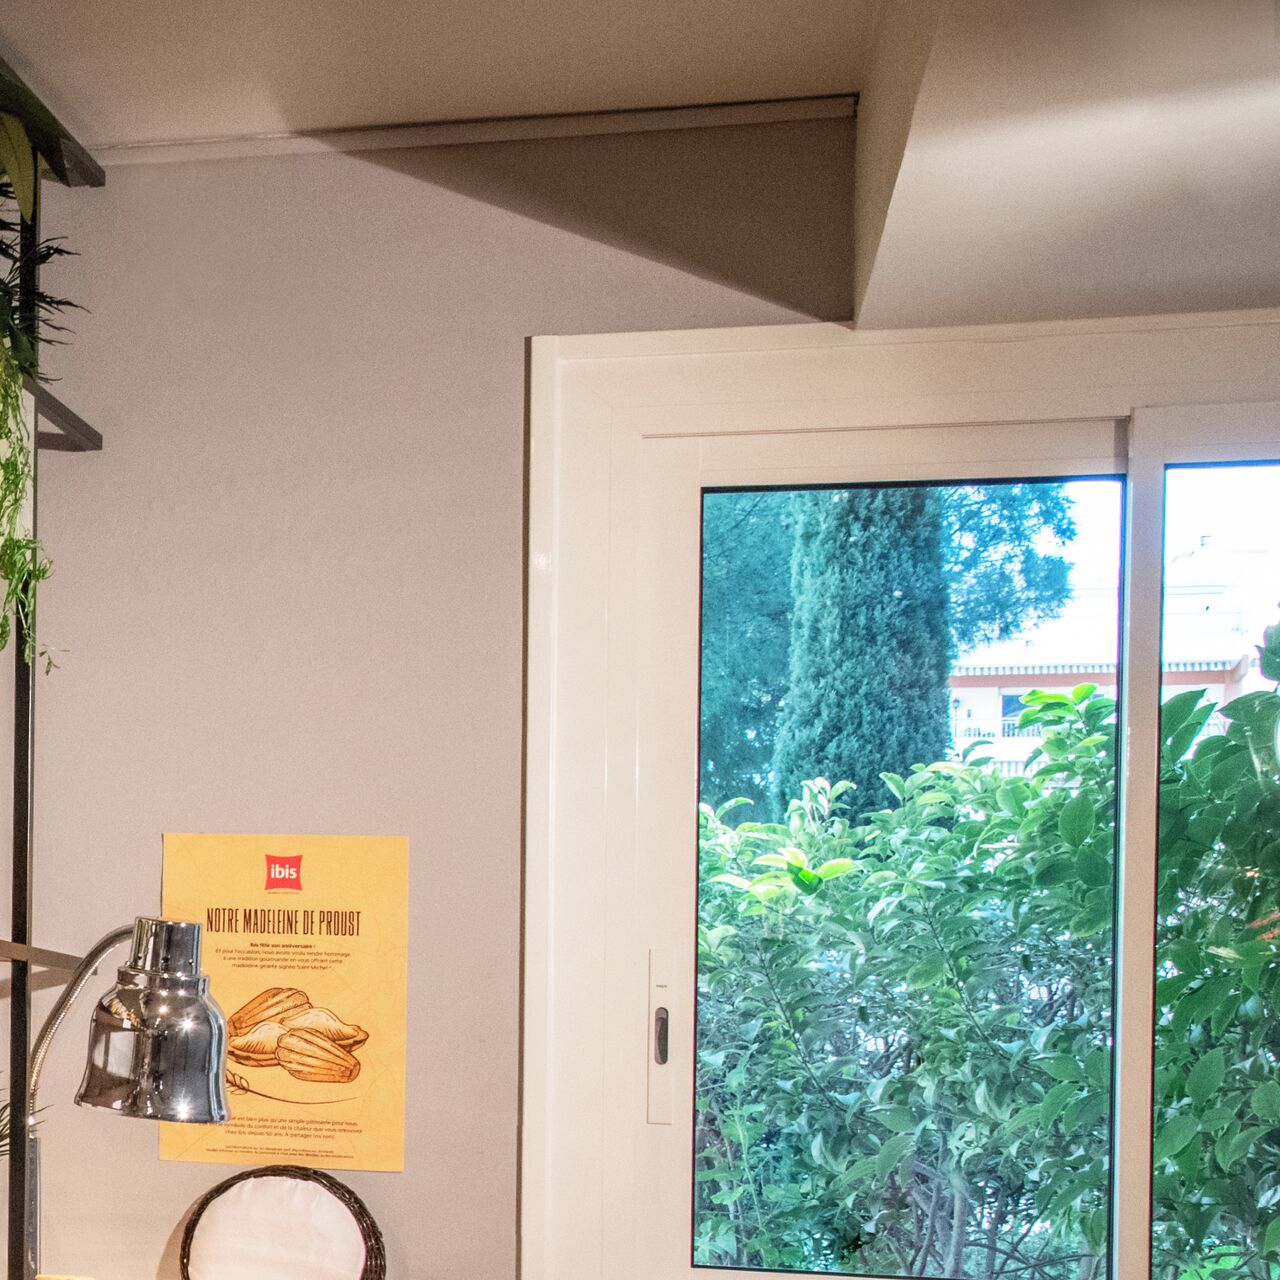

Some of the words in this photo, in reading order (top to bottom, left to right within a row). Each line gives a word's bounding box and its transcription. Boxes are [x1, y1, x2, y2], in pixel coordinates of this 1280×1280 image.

[270, 863, 297, 879] ibis
[206, 907, 239, 933] NOTRE
[243, 908, 299, 935] MADELEINE
[303, 910, 314, 935] DE
[319, 910, 361, 937] PROUST
